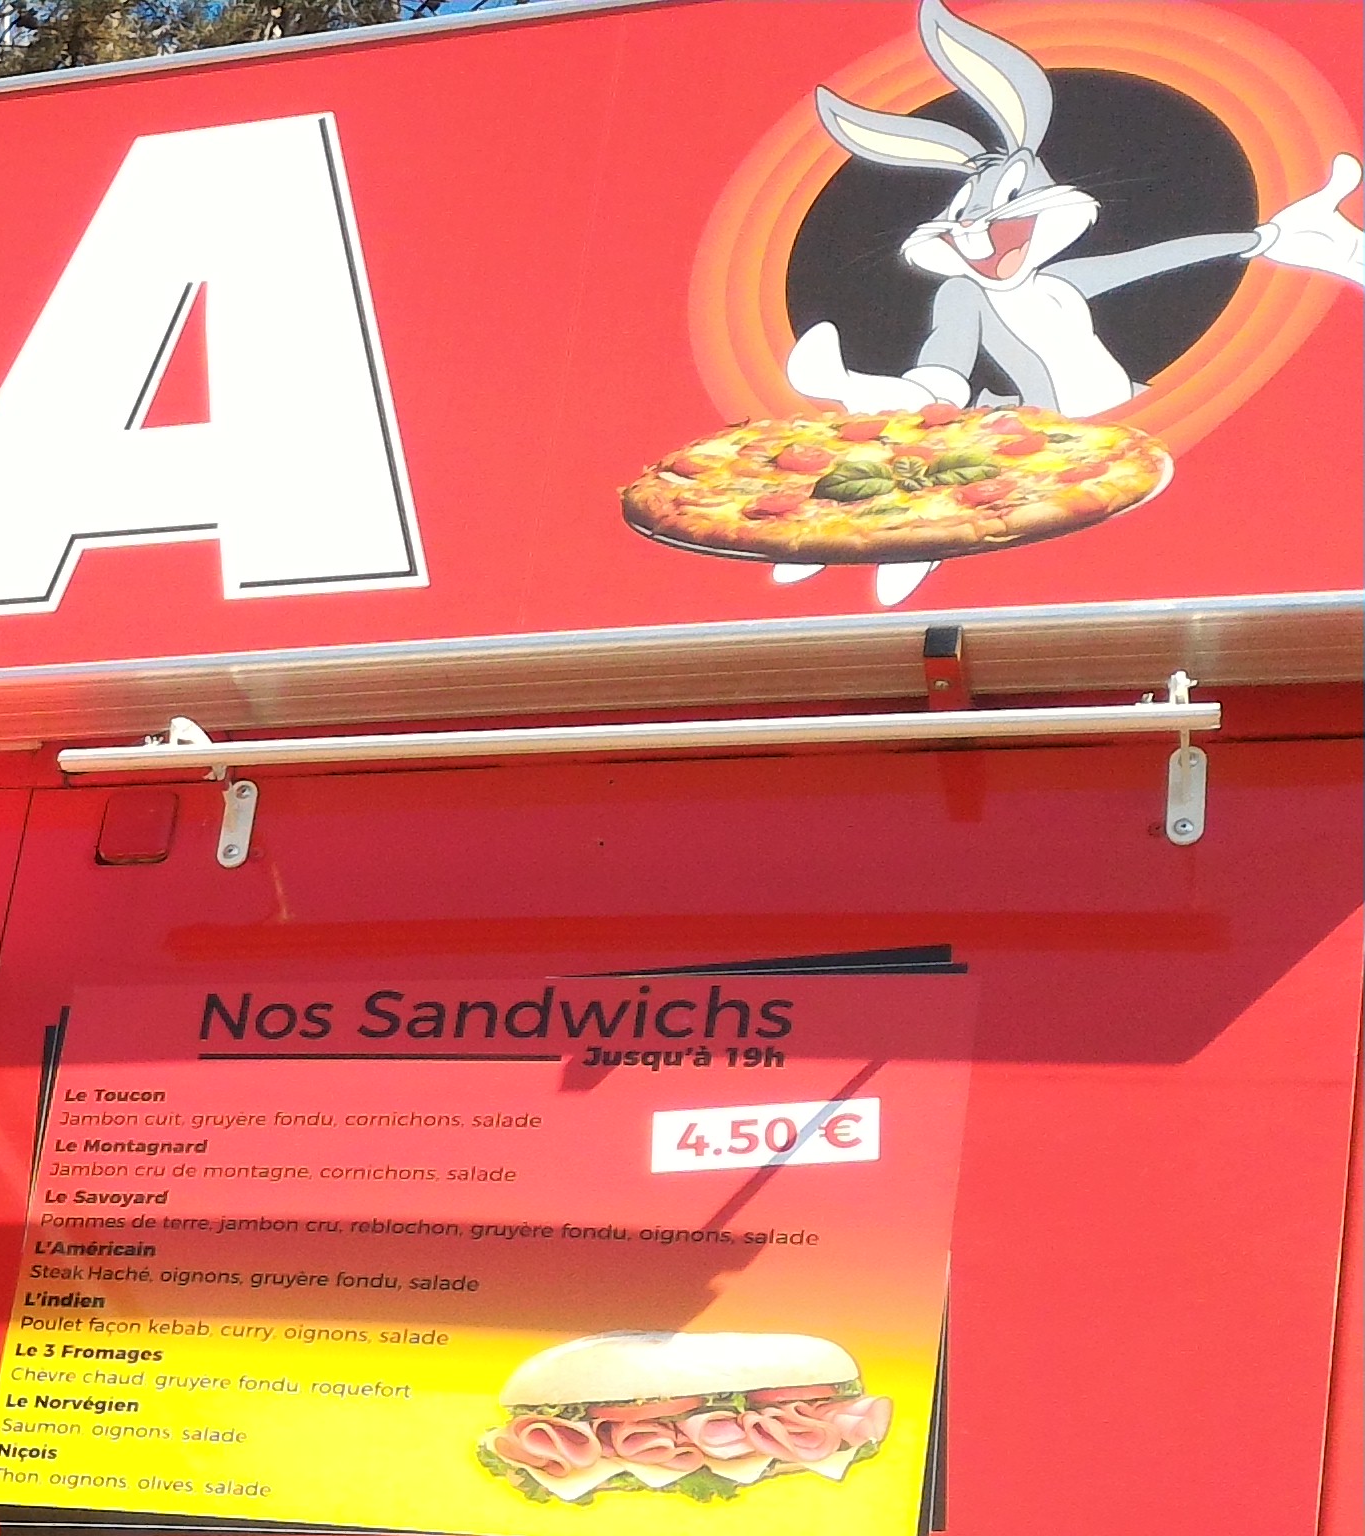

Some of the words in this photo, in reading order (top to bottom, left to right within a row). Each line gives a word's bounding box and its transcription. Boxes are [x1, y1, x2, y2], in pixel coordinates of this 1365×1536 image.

[198, 992, 334, 1042] Nos
[357, 984, 794, 1042] Sandwichs
[583, 1045, 712, 1072] Jusqu'à
[726, 1045, 787, 1069] 19h
[65, 1088, 88, 1102] Le
[94, 1088, 166, 1102] Toucon
[59, 1111, 138, 1127] Jambon
[191, 1111, 267, 1130] gruyère
[273, 1111, 338, 1128] fondu,
[345, 1112, 465, 1128] cornichons,
[471, 1112, 543, 1129] salade
[676, 1116, 799, 1158] 4.50
[817, 1112, 864, 1150] €
[54, 1139, 78, 1153] Le
[83, 1139, 209, 1156] Montagnard
[49, 1162, 128, 1178] Jambon
[135, 1166, 166, 1178] cru
[172, 1163, 197, 1178] de
[203, 1165, 313, 1182] montagne,
[320, 1165, 440, 1182] cornichons,
[447, 1165, 517, 1183] salade
[44, 1189, 68, 1204] Le
[73, 1189, 170, 1208] Savoyard
[40, 1213, 126, 1230] Pommes
[132, 1213, 157, 1229] de
[163, 1215, 213, 1231] terre,
[216, 1216, 299, 1234] jambon
[306, 1220, 344, 1234] cru,
[350, 1218, 463, 1238] reblochon,
[470, 1220, 554, 1240] gruyère
[561, 1222, 633, 1243] fondu,
[639, 1225, 736, 1247] oignons,
[743, 1227, 820, 1246] salade
[34, 1240, 157, 1258] L'Américain
[29, 1264, 84, 1281] Steak
[87, 1266, 153, 1283] Haché,
[160, 1267, 244, 1286] oignons,
[250, 1270, 329, 1289] gruyère
[336, 1270, 403, 1291] fondu,
[409, 1274, 480, 1292] salade
[23, 1291, 106, 1309] L'indien
[20, 1315, 84, 1333] Poulet
[88, 1317, 141, 1337] façon
[378, 1327, 451, 1346] salade
[15, 1342, 38, 1357] Le
[43, 1343, 56, 1358] 3
[61, 1344, 164, 1363] Fromages
[10, 1366, 77, 1383] Chèvre
[155, 1373, 232, 1391] gruyère
[310, 1380, 412, 1400] roquefort
[5, 1392, 29, 1408] Le
[34, 1393, 139, 1416] Norvégien
[181, 1425, 248, 1444] salade
[204, 1479, 272, 1498] salade
